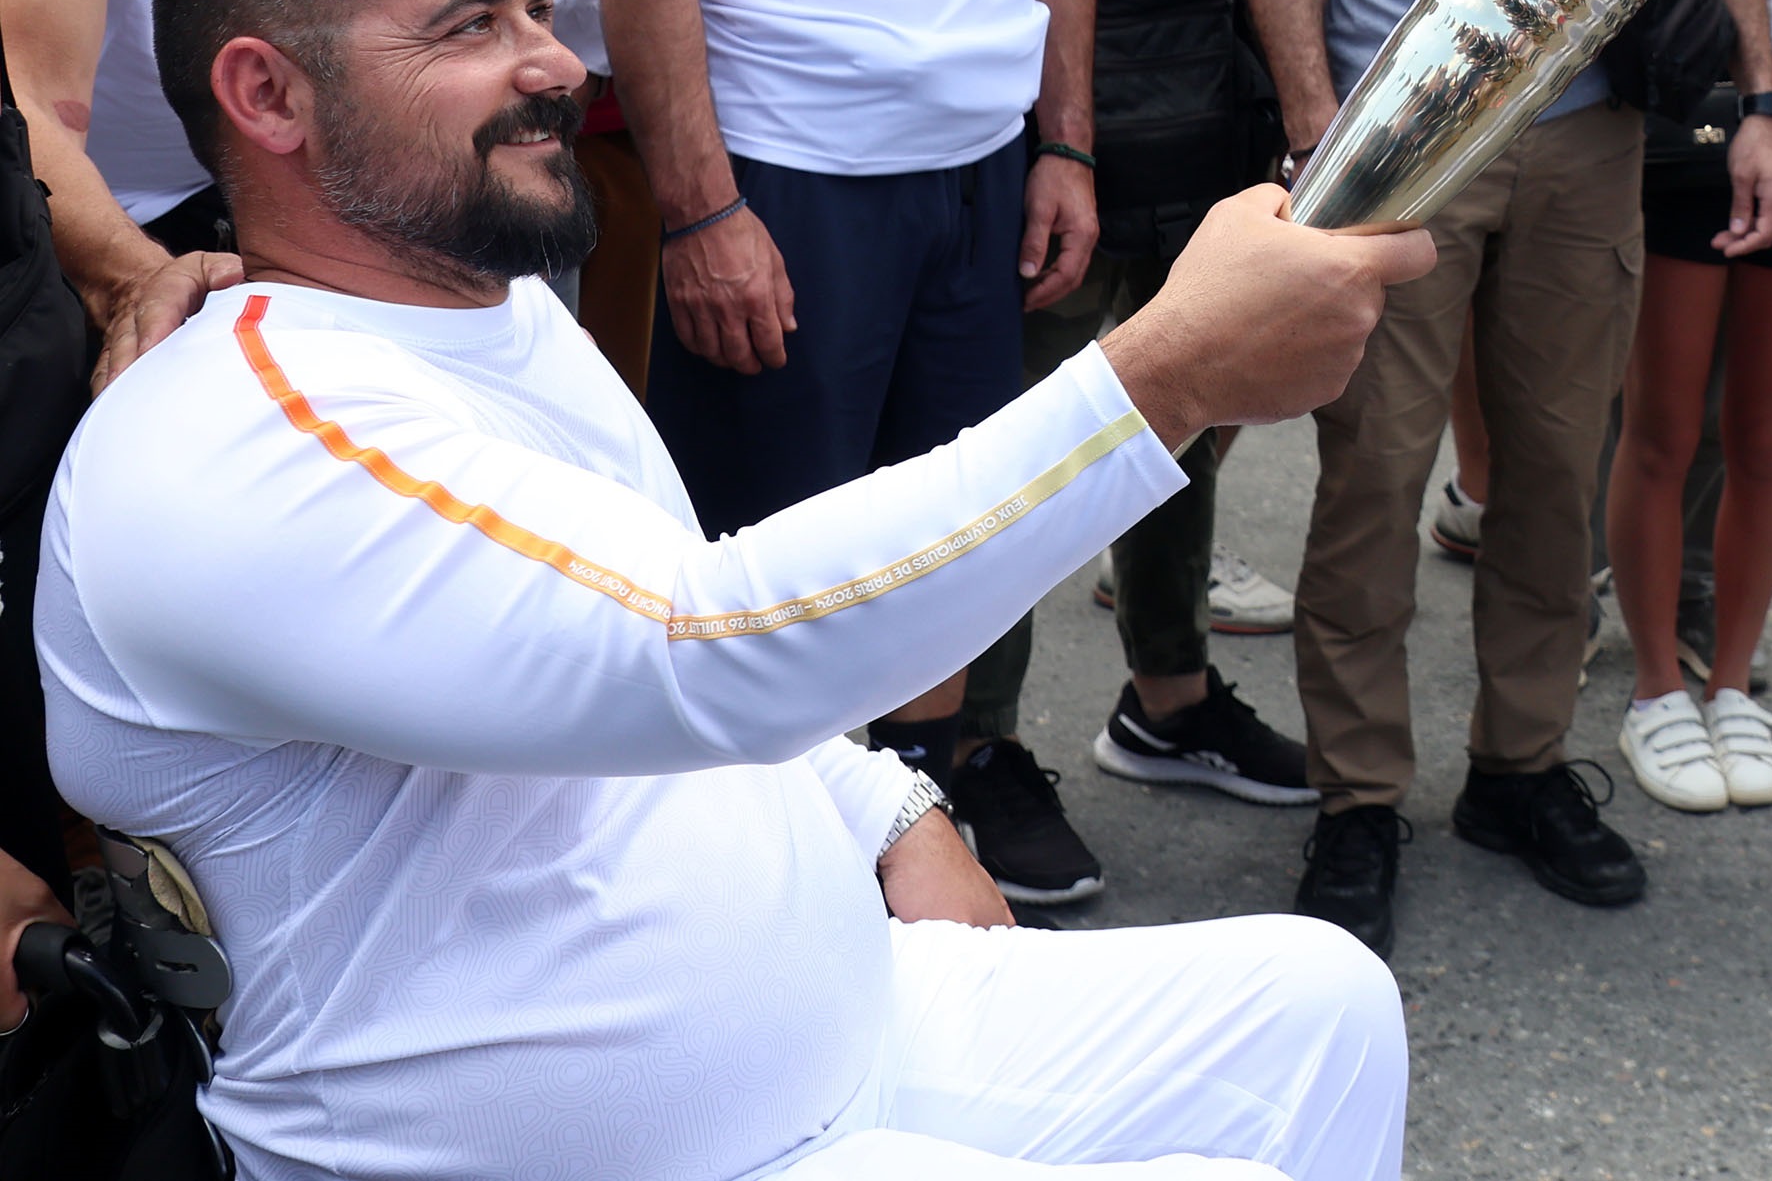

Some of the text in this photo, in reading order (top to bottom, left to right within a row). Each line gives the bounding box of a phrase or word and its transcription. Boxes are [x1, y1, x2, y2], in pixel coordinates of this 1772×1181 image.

[996, 494, 1030, 522] JEUX
[912, 517, 998, 571] OLYMPIQUES
[569, 560, 601, 583] 2024
[893, 564, 913, 582] DE
[854, 572, 893, 598] PARIS
[815, 586, 855, 610] 2024
[727, 616, 748, 631] 26
